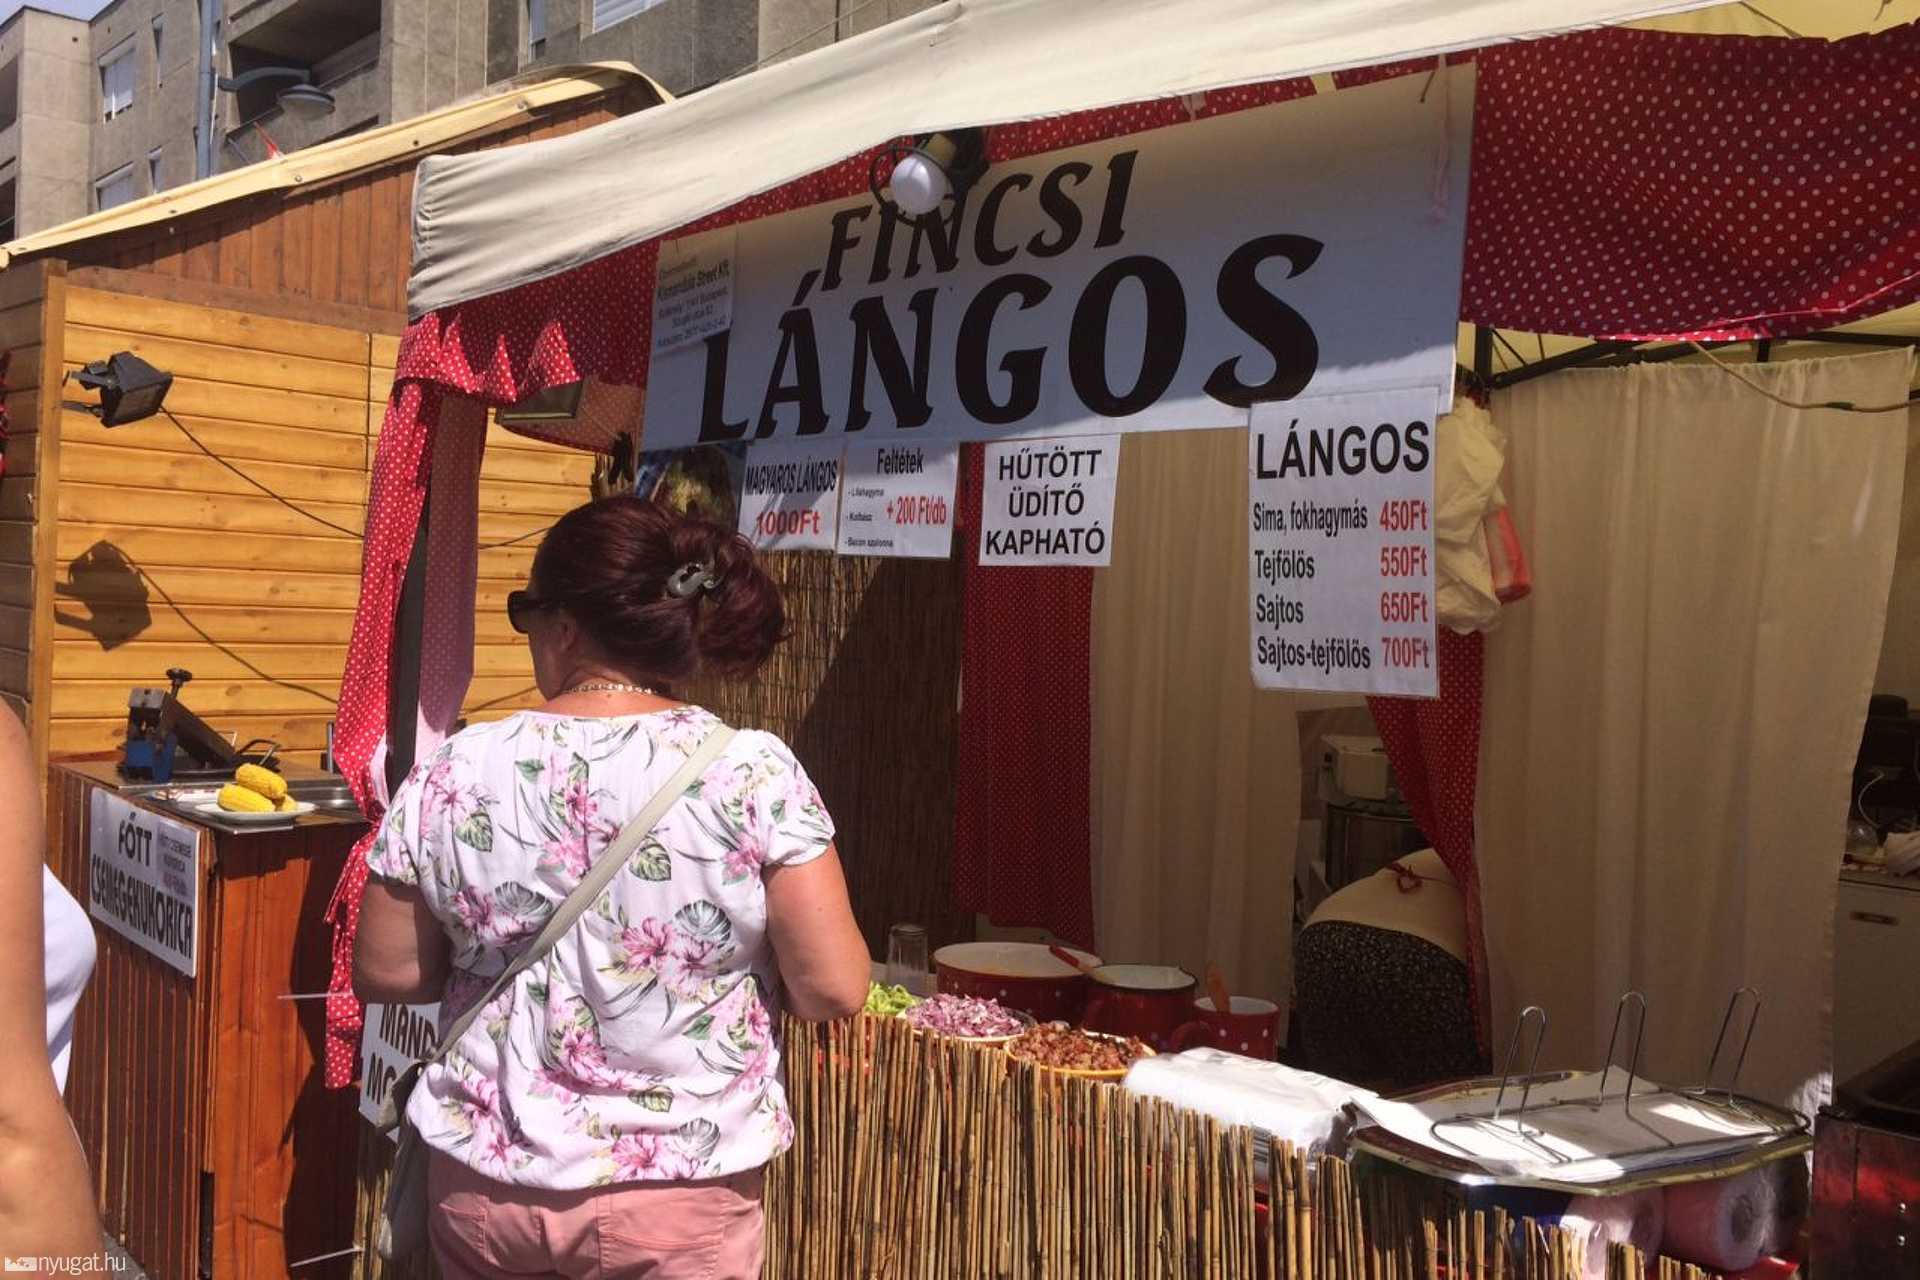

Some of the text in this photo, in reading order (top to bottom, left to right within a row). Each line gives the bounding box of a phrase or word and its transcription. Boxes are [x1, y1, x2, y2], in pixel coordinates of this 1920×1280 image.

[821, 150, 1138, 292] FINCSI
[698, 233, 1325, 444] LÁNGOS
[877, 447, 923, 475] Feltétek
[999, 446, 1102, 480] HŰTÖTT
[1256, 419, 1430, 479] LÁNGOS
[745, 455, 838, 496] MAGYAROS LÁNGOS
[896, 496, 915, 524] 200
[1008, 482, 1085, 517] ÜDÍTŐ
[1253, 498, 1428, 537] Sima, fokhagymás 450Ft
[756, 508, 820, 536] 1000Ft
[986, 521, 1105, 555] KAPHATÓ
[1254, 546, 1427, 586] Tejfölös 550Ft
[1256, 592, 1428, 630] Sajtos 650Ft
[1257, 635, 1429, 674] Sajtos-tejfölös 700Ft
[118, 811, 152, 867] FŐTT
